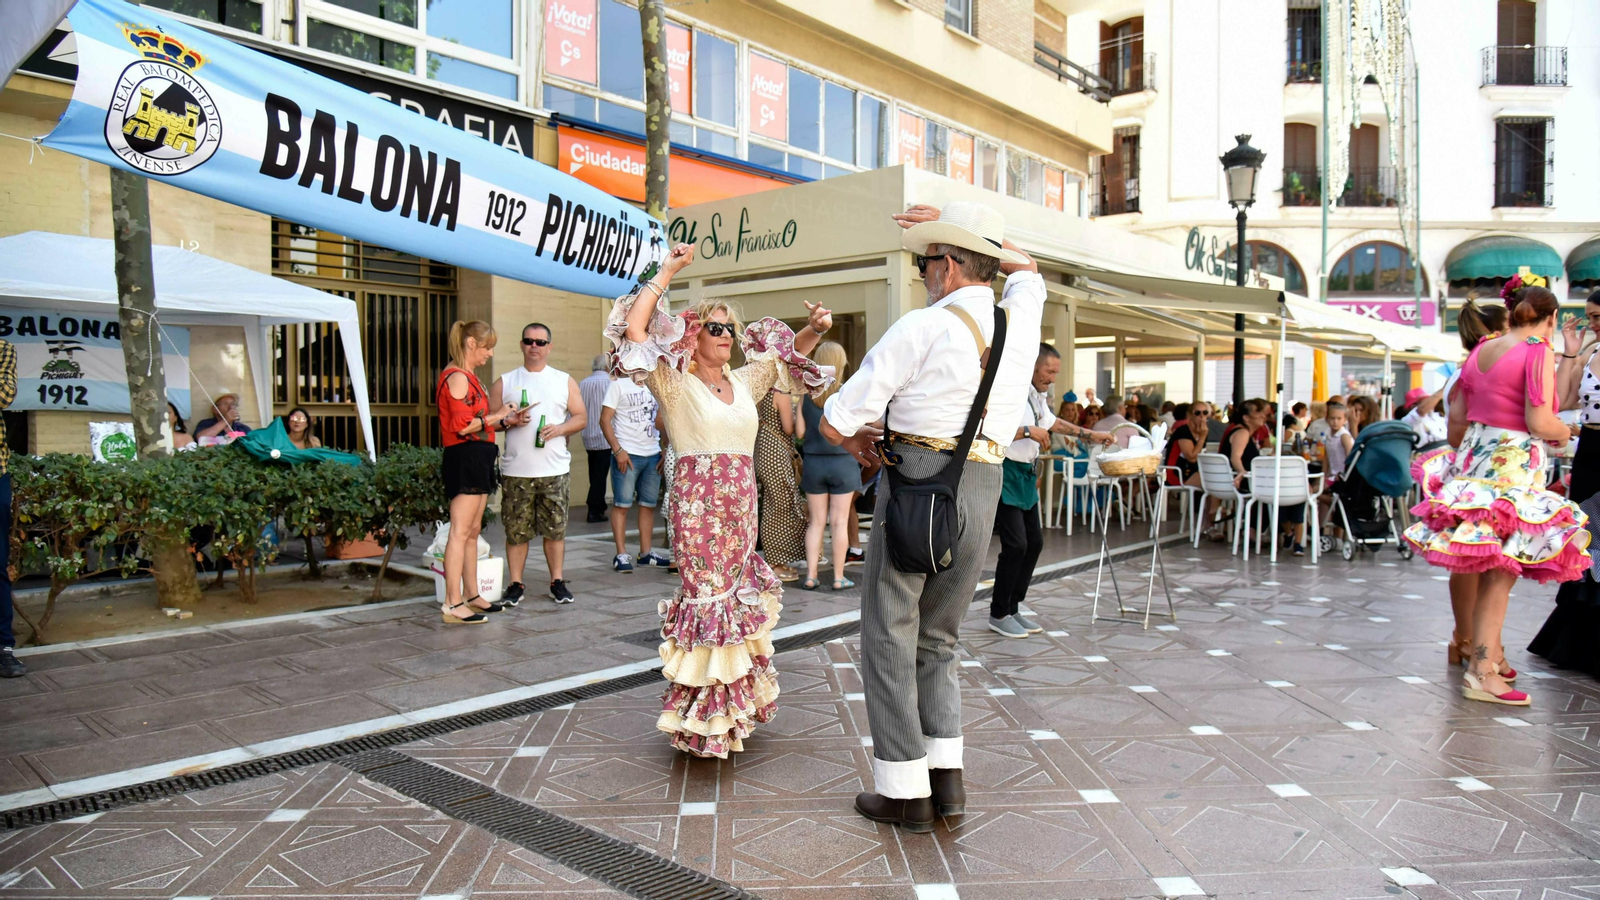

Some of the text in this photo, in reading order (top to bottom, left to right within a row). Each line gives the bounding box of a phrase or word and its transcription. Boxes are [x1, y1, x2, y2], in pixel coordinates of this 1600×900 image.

[560, 40, 581, 59] Cs
[113, 77, 136, 112] REAL
[760, 104, 775, 121] Cs
[117, 145, 183, 173] LINENSE
[260, 92, 644, 281] BALONA 1912 PICHIGÜEY
[700, 212, 733, 260] San
[0, 315, 121, 340] BALONA
[37, 384, 89, 406] 1912
